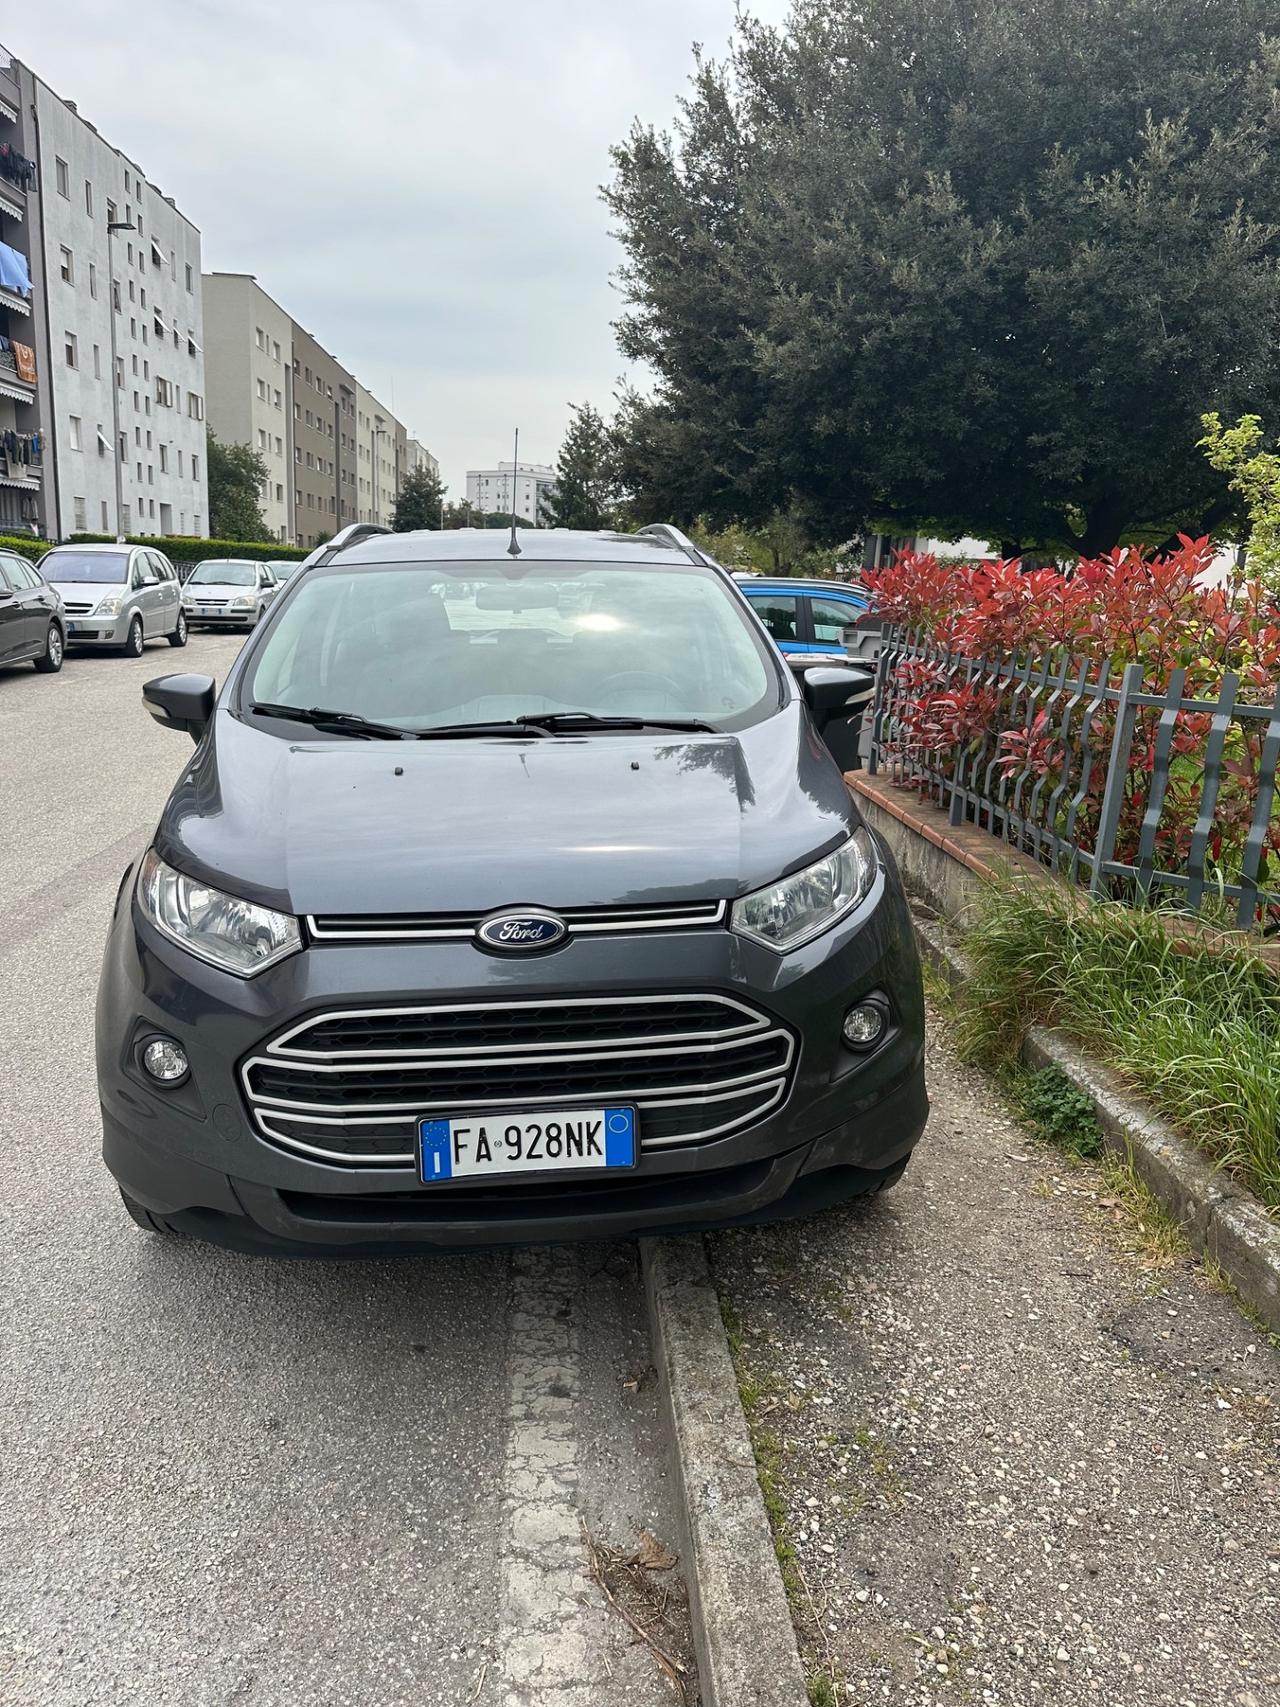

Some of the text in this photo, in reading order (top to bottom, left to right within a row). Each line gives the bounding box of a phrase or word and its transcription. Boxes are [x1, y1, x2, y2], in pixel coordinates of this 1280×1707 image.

[499, 921, 543, 940] Ford
[453, 1120, 603, 1165] FA 928NK
